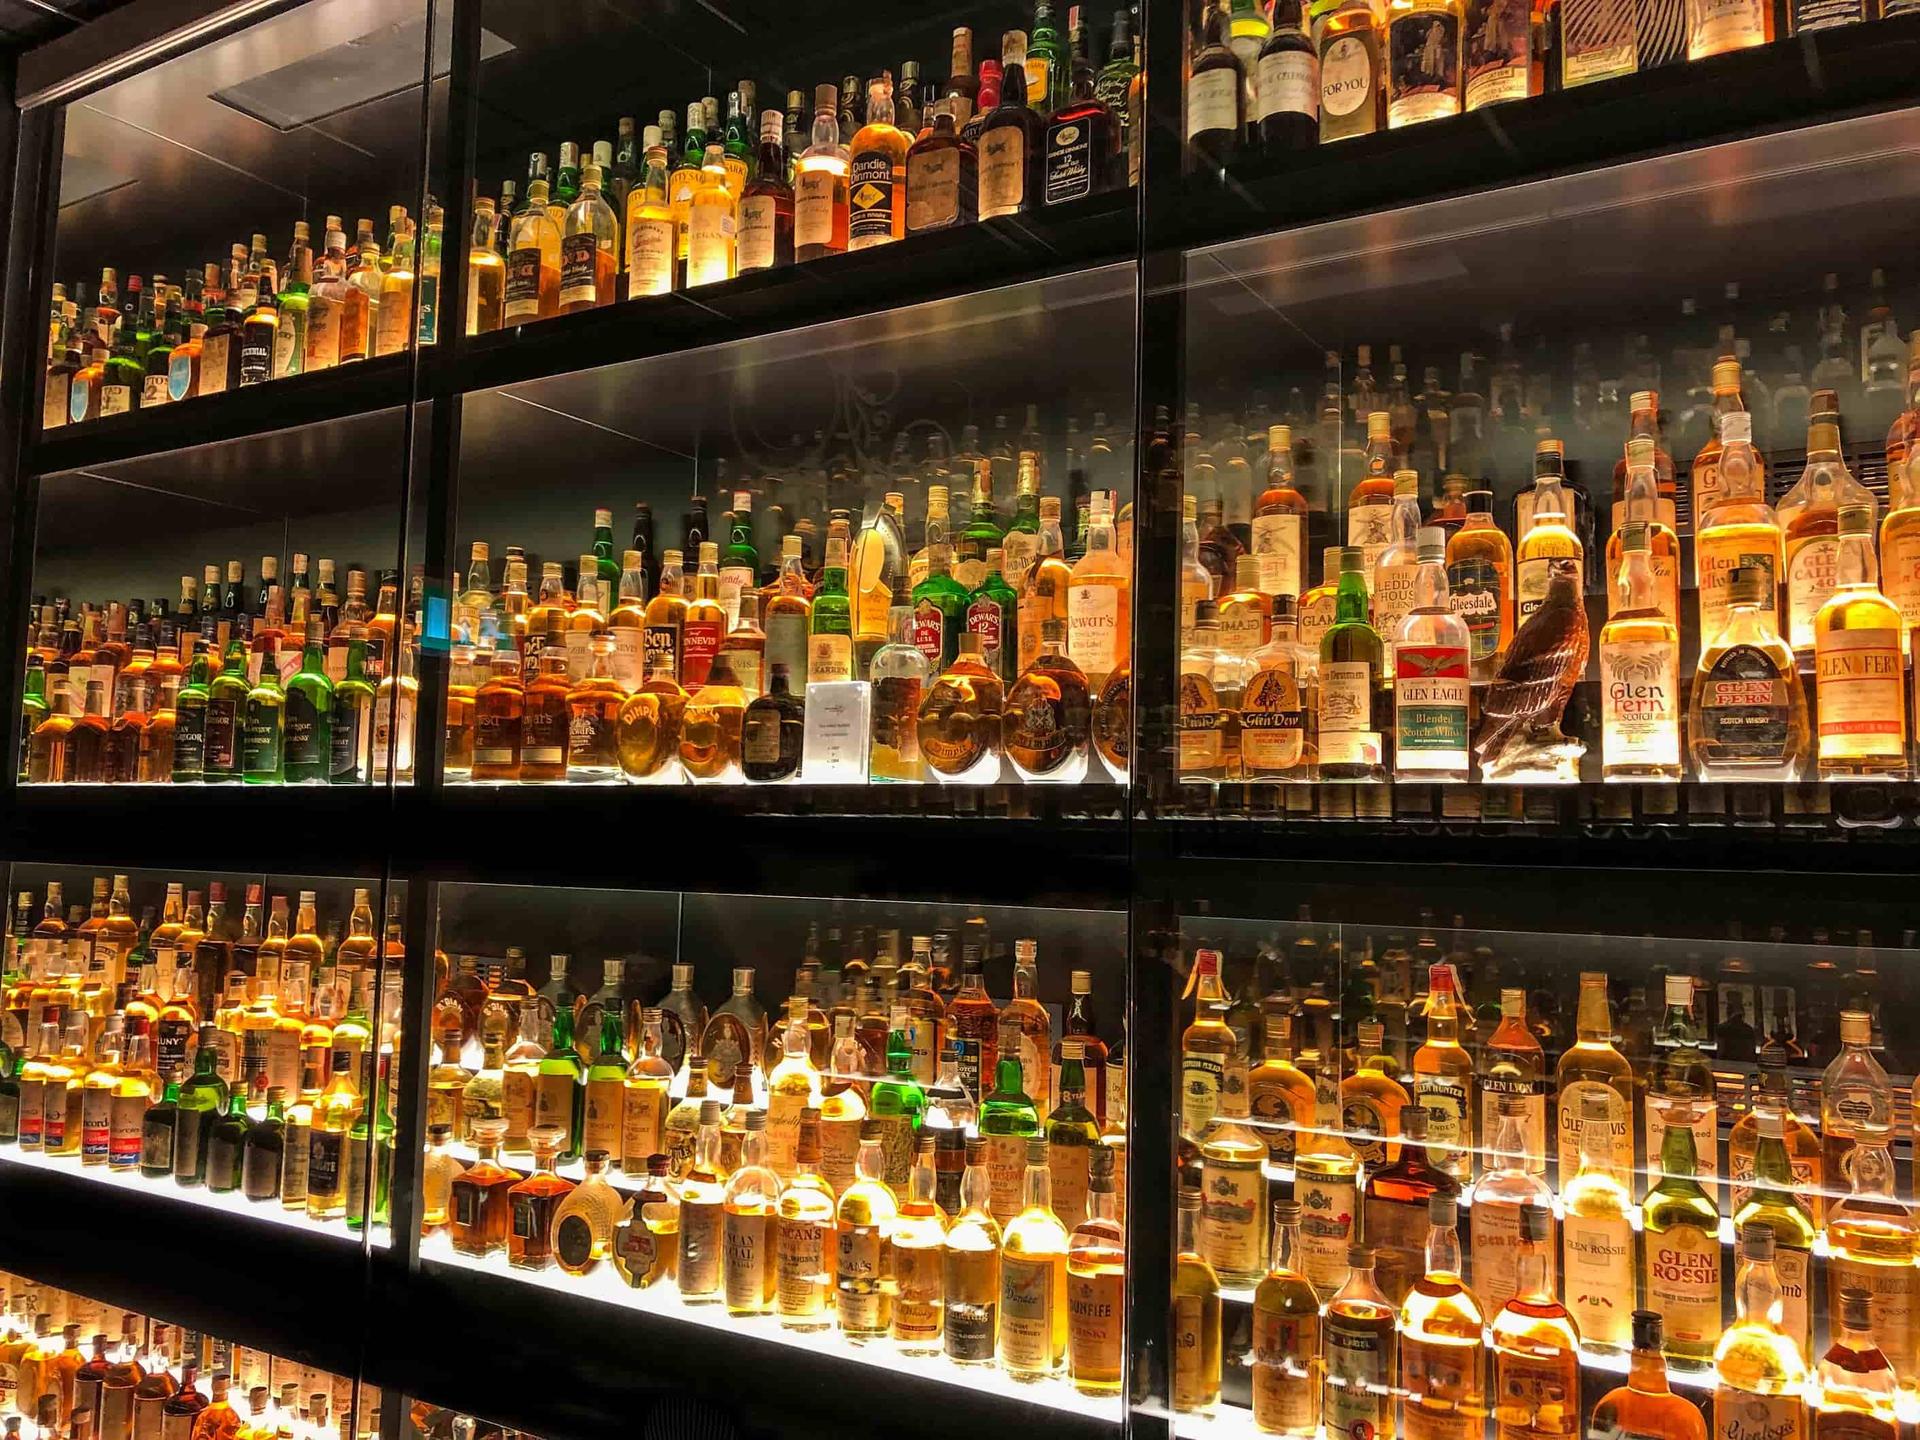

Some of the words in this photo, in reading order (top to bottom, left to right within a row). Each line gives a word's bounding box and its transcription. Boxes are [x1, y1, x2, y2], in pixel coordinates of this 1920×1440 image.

[1323, 80, 1341, 98] FOR
[1344, 78, 1367, 92] YOU
[852, 159, 886, 171] Dandie
[851, 170, 890, 184] Dinmont
[1803, 554, 1836, 568] GLE
[1381, 590, 1414, 602] HOUS
[1387, 601, 1413, 609] BLEN
[1450, 595, 1493, 612] Gleesdale
[978, 622, 989, 633] 12
[1303, 615, 1336, 627] GLAM
[644, 628, 672, 648] Ben
[1610, 682, 1664, 700] Glen
[1715, 681, 1773, 693] GLEN
[1403, 688, 1428, 701] GLEN
[1432, 688, 1464, 701] EAGLE
[1715, 693, 1773, 705] FERN
[1246, 713, 1272, 727] Glen
[1274, 713, 1298, 727] Dew
[1416, 713, 1453, 724] Blended
[1720, 717, 1743, 725] SCOTCH
[1746, 716, 1769, 724] WHISKY
[1484, 1079, 1506, 1091] GLEN
[1509, 1080, 1533, 1094] LYON
[1659, 1249, 1713, 1267] GLEN
[1653, 1263, 1718, 1284] ROSSIE
